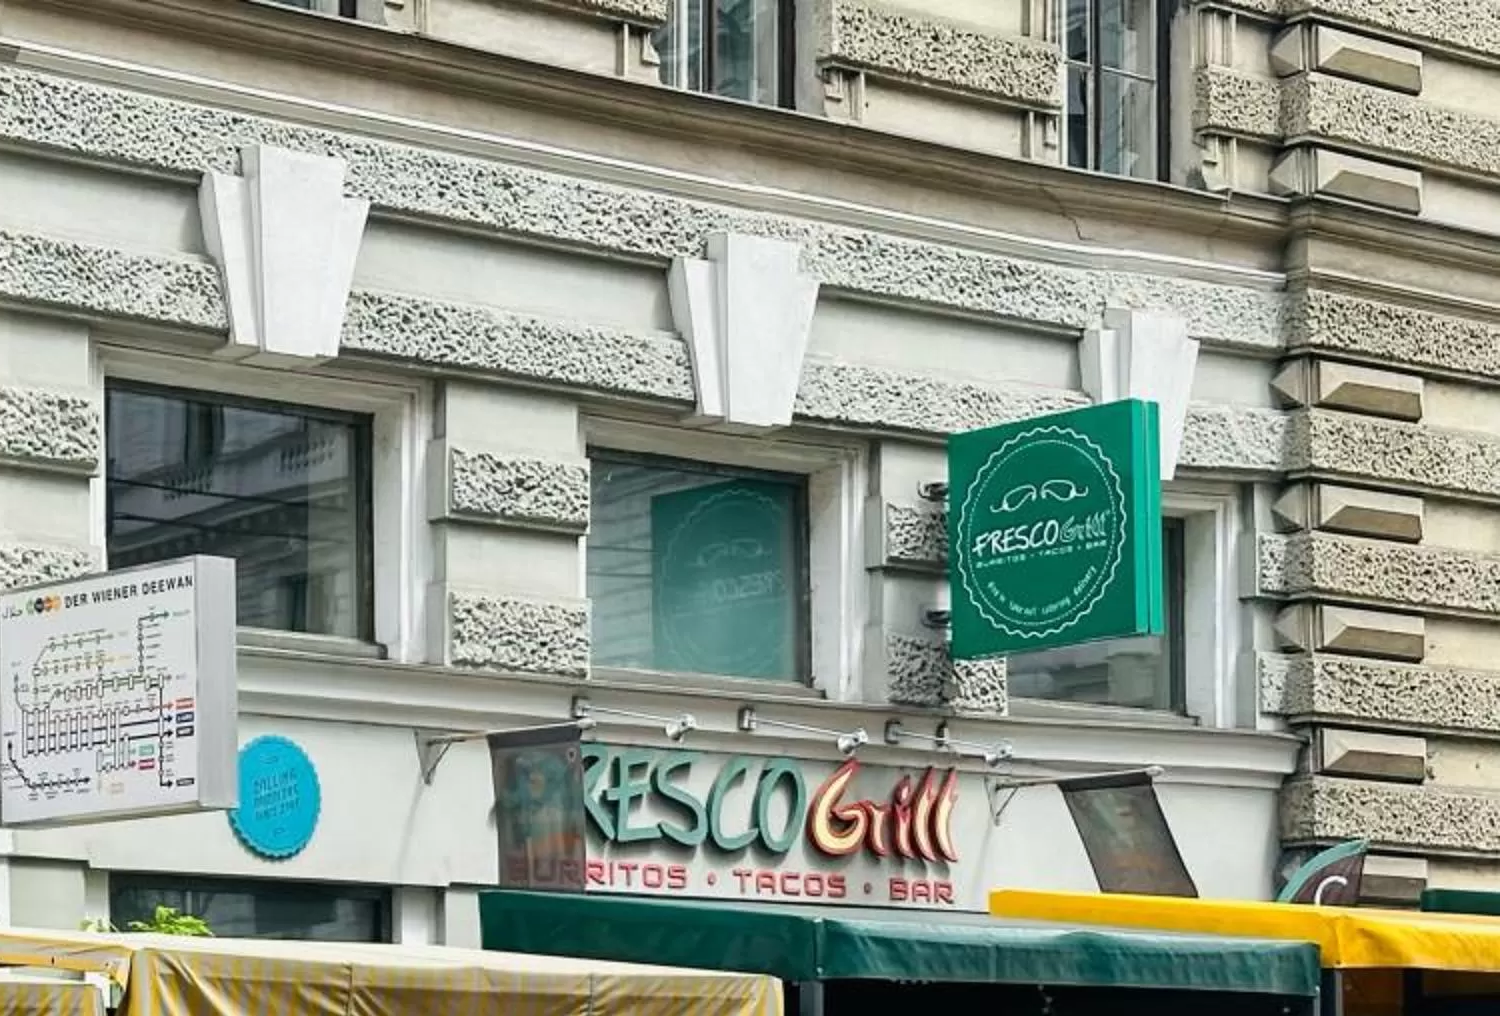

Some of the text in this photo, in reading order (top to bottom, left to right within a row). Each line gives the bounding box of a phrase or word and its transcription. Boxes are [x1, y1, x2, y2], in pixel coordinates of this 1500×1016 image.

[64, 575, 193, 609] DER WIENER DEEWAN
[733, 868, 847, 899] TACOS
[889, 878, 956, 906] BAR
